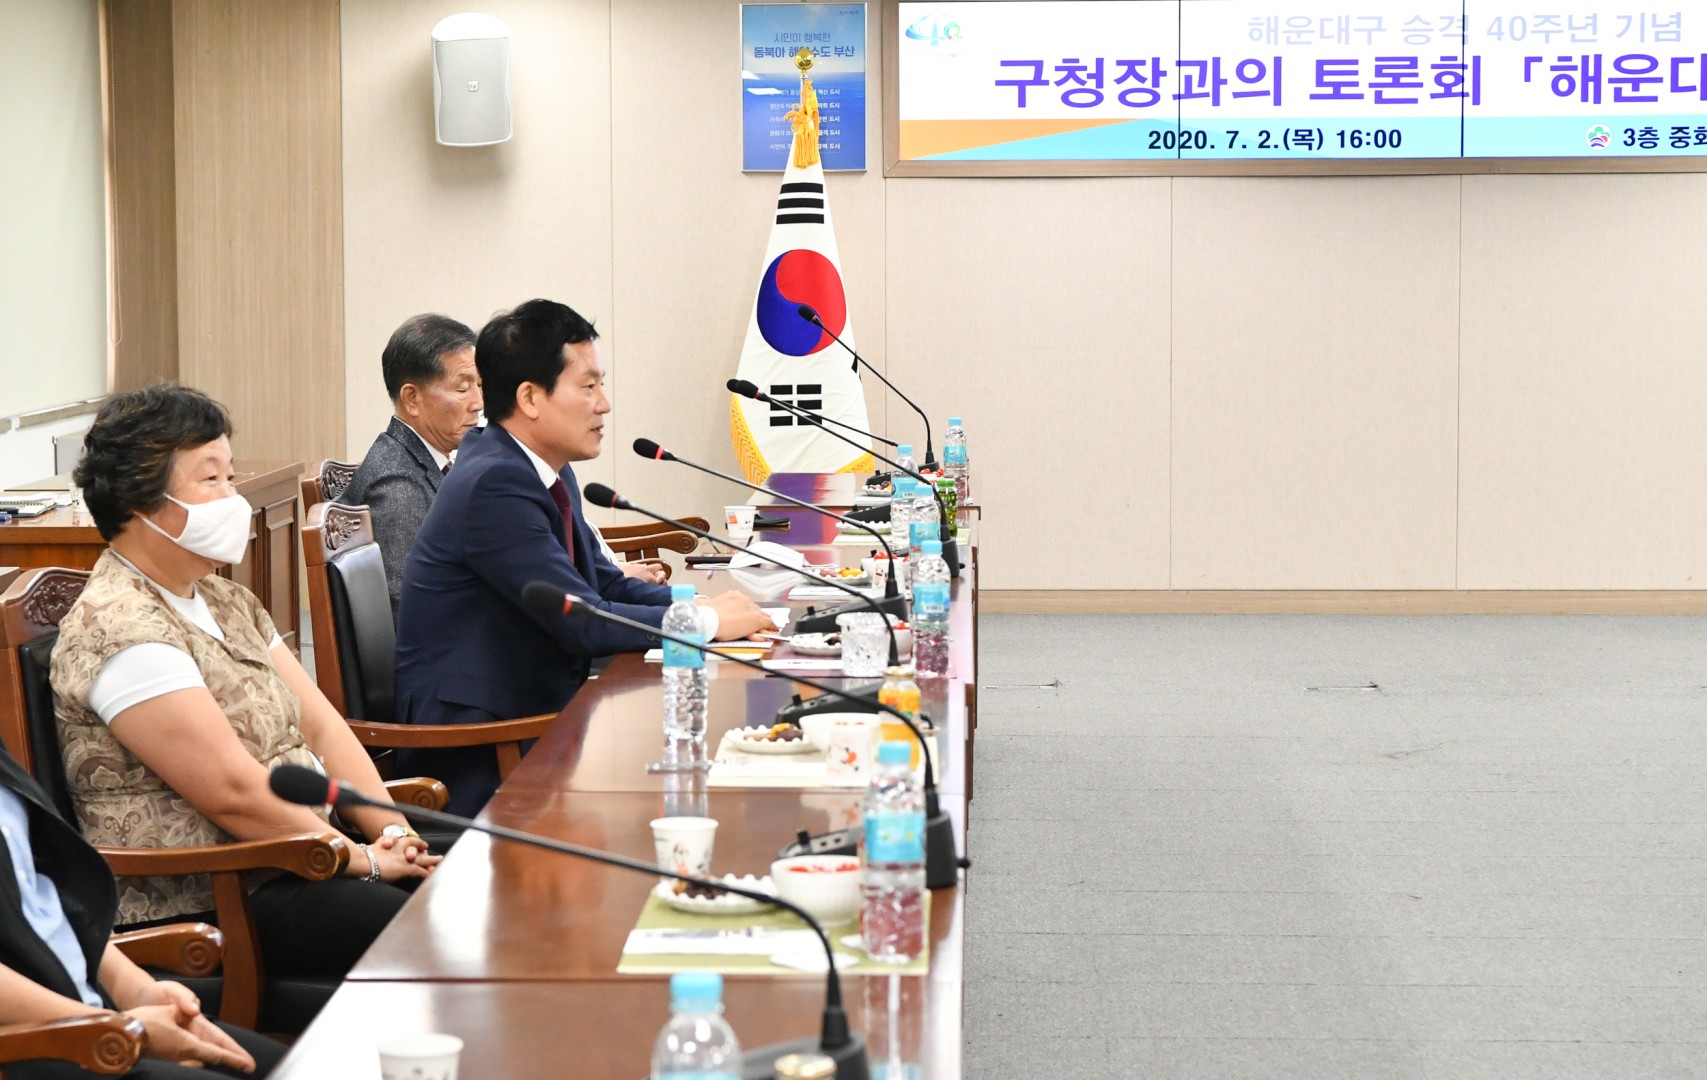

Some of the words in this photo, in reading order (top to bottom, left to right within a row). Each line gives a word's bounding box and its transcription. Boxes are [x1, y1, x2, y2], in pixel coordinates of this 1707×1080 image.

[774, 32, 801, 43] 시민이
[804, 32, 831, 43] 행복한
[1247, 15, 1386, 46] 해운대구
[1400, 14, 1469, 46] 승격
[1486, 12, 1598, 43] 40주년
[1615, 11, 1682, 43] 기념
[753, 46, 785, 58] 동북아
[788, 46, 831, 58] 해수도
[834, 46, 855, 57] 부산
[994, 56, 1283, 108] 구청장과의
[1309, 54, 1481, 106] 토론회
[1148, 130, 1216, 150] 2020.
[1225, 130, 1247, 150] 7.
[1257, 129, 1324, 151] 2.(목)
[1336, 129, 1402, 149] 16:00
[1623, 126, 1660, 149] 3층
